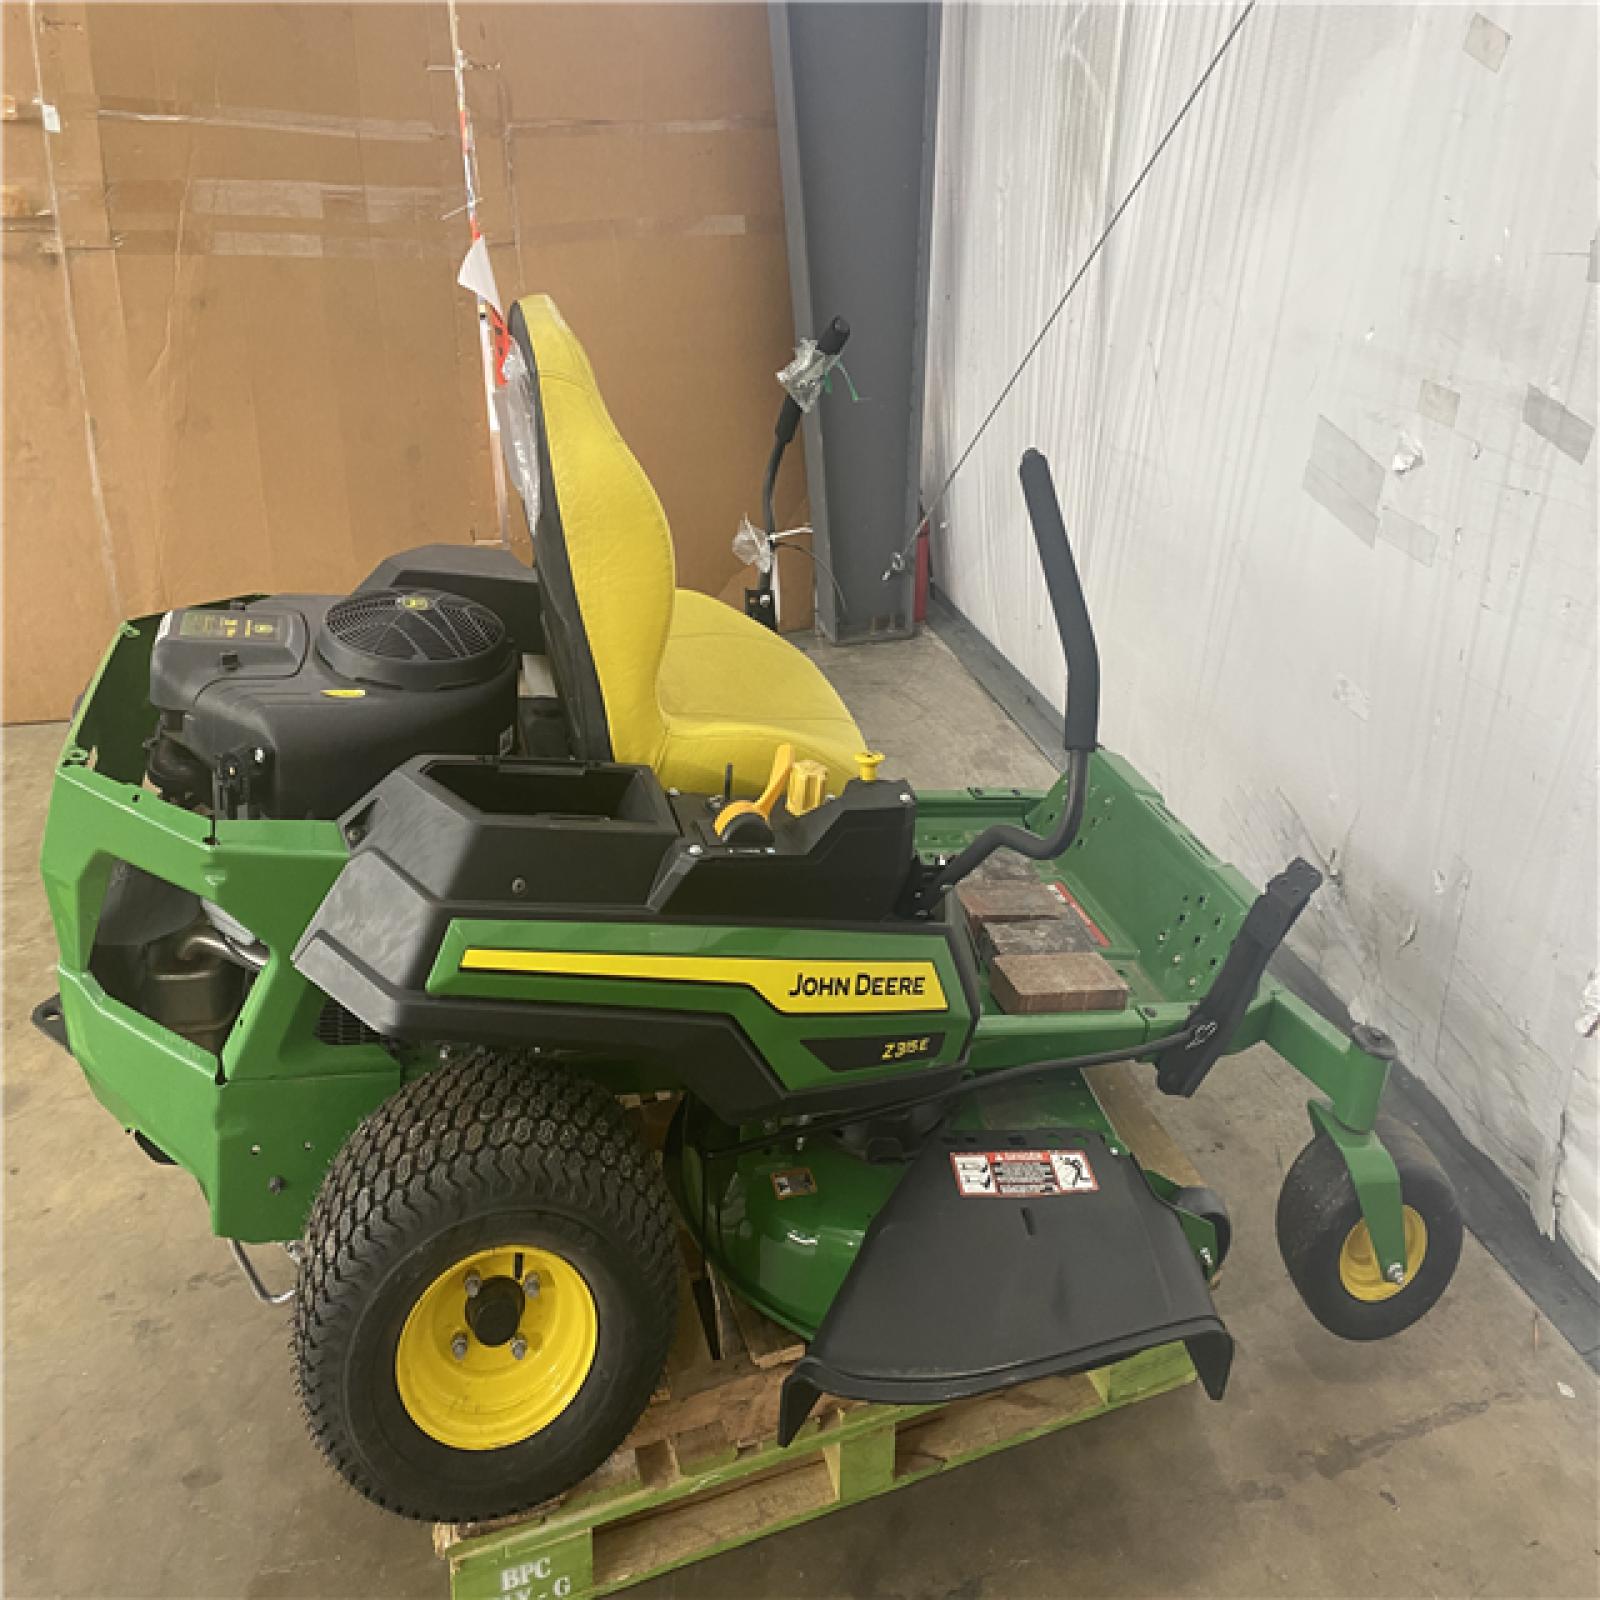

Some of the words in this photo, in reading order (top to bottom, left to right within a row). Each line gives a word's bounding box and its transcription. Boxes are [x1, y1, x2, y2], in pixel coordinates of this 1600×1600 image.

[789, 972, 850, 996] JOHN
[855, 972, 925, 996] DEERE
[502, 1557, 551, 1591] BPC
